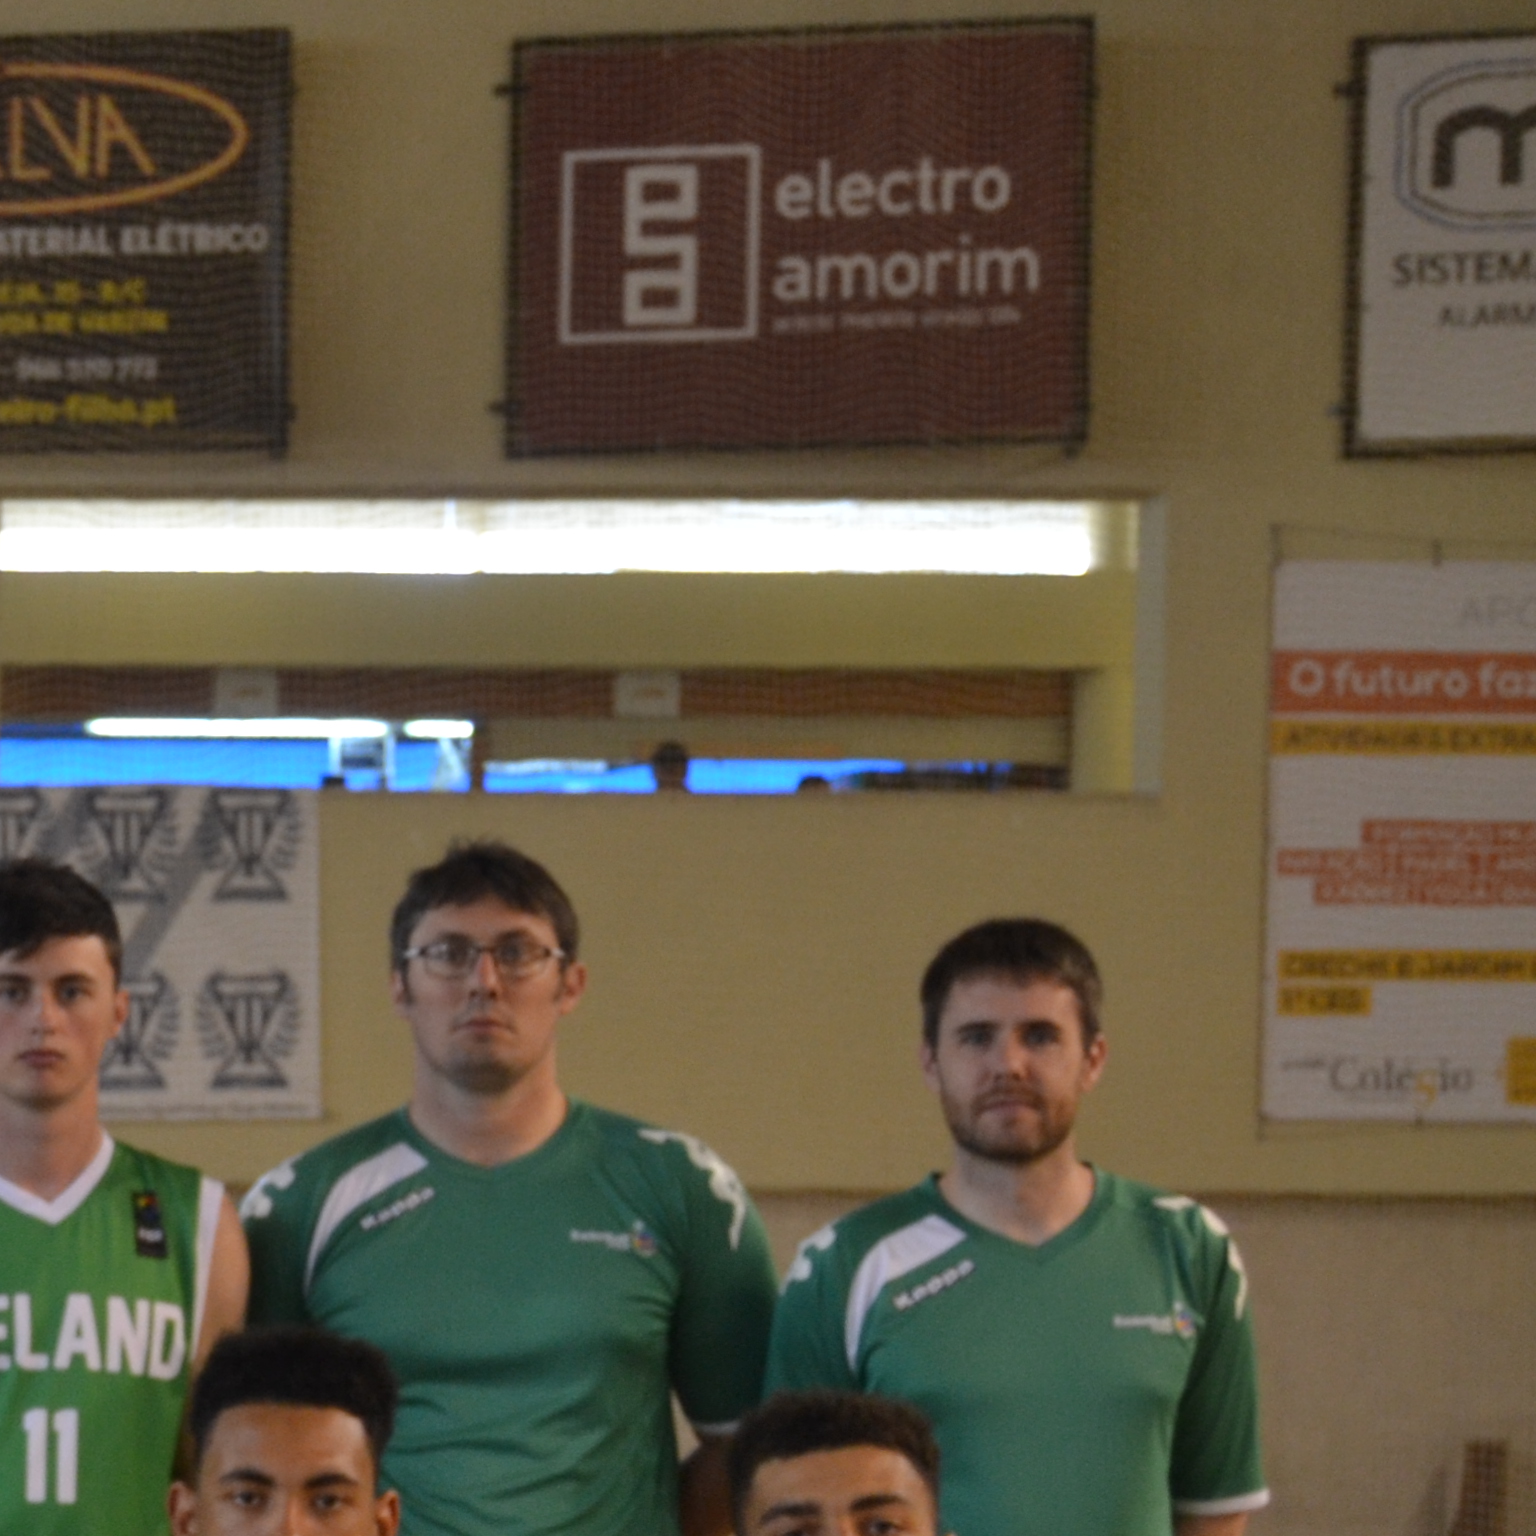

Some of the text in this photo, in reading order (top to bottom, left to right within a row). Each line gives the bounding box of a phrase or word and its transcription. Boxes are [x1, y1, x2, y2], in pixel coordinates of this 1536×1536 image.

[773, 156, 1011, 219] electro
[119, 221, 269, 254] ELÉTRICO
[773, 232, 1040, 304] amorim
[1392, 250, 1536, 287] SISTEM
[1289, 658, 1325, 697] O
[1332, 659, 1470, 698] futuro
[22, 1406, 80, 1505] 11
